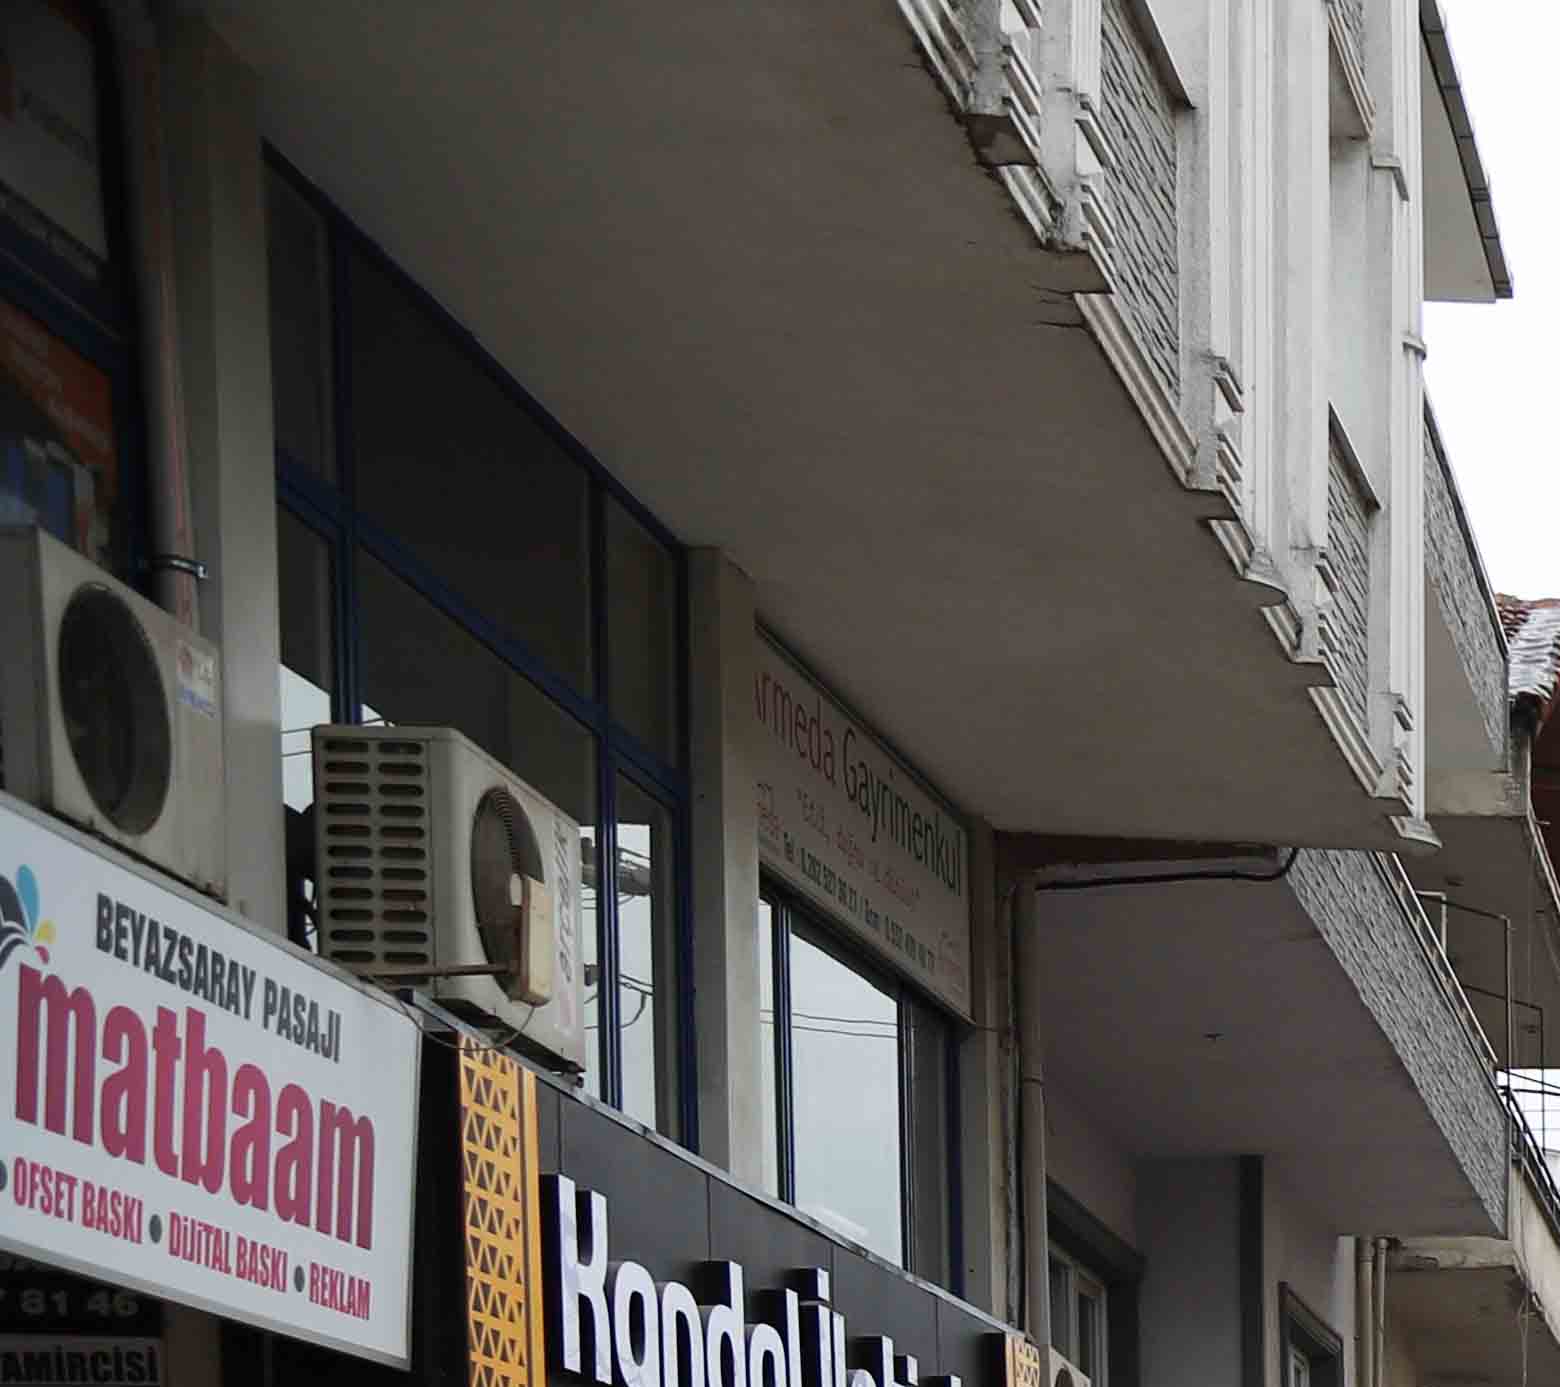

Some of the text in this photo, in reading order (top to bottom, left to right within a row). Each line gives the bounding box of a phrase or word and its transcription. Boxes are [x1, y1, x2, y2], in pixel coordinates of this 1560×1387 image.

[843, 728, 960, 896] Gayrimenkul
[95, 893, 340, 1063] BEYAZSARAY PASAJI
[15, 962, 375, 1251] matbaam
[13, 1155, 77, 1224] OFSET
[81, 1179, 143, 1245] BASKI
[236, 1242, 287, 1293] BASKI
[309, 1262, 371, 1321] REKLAM
